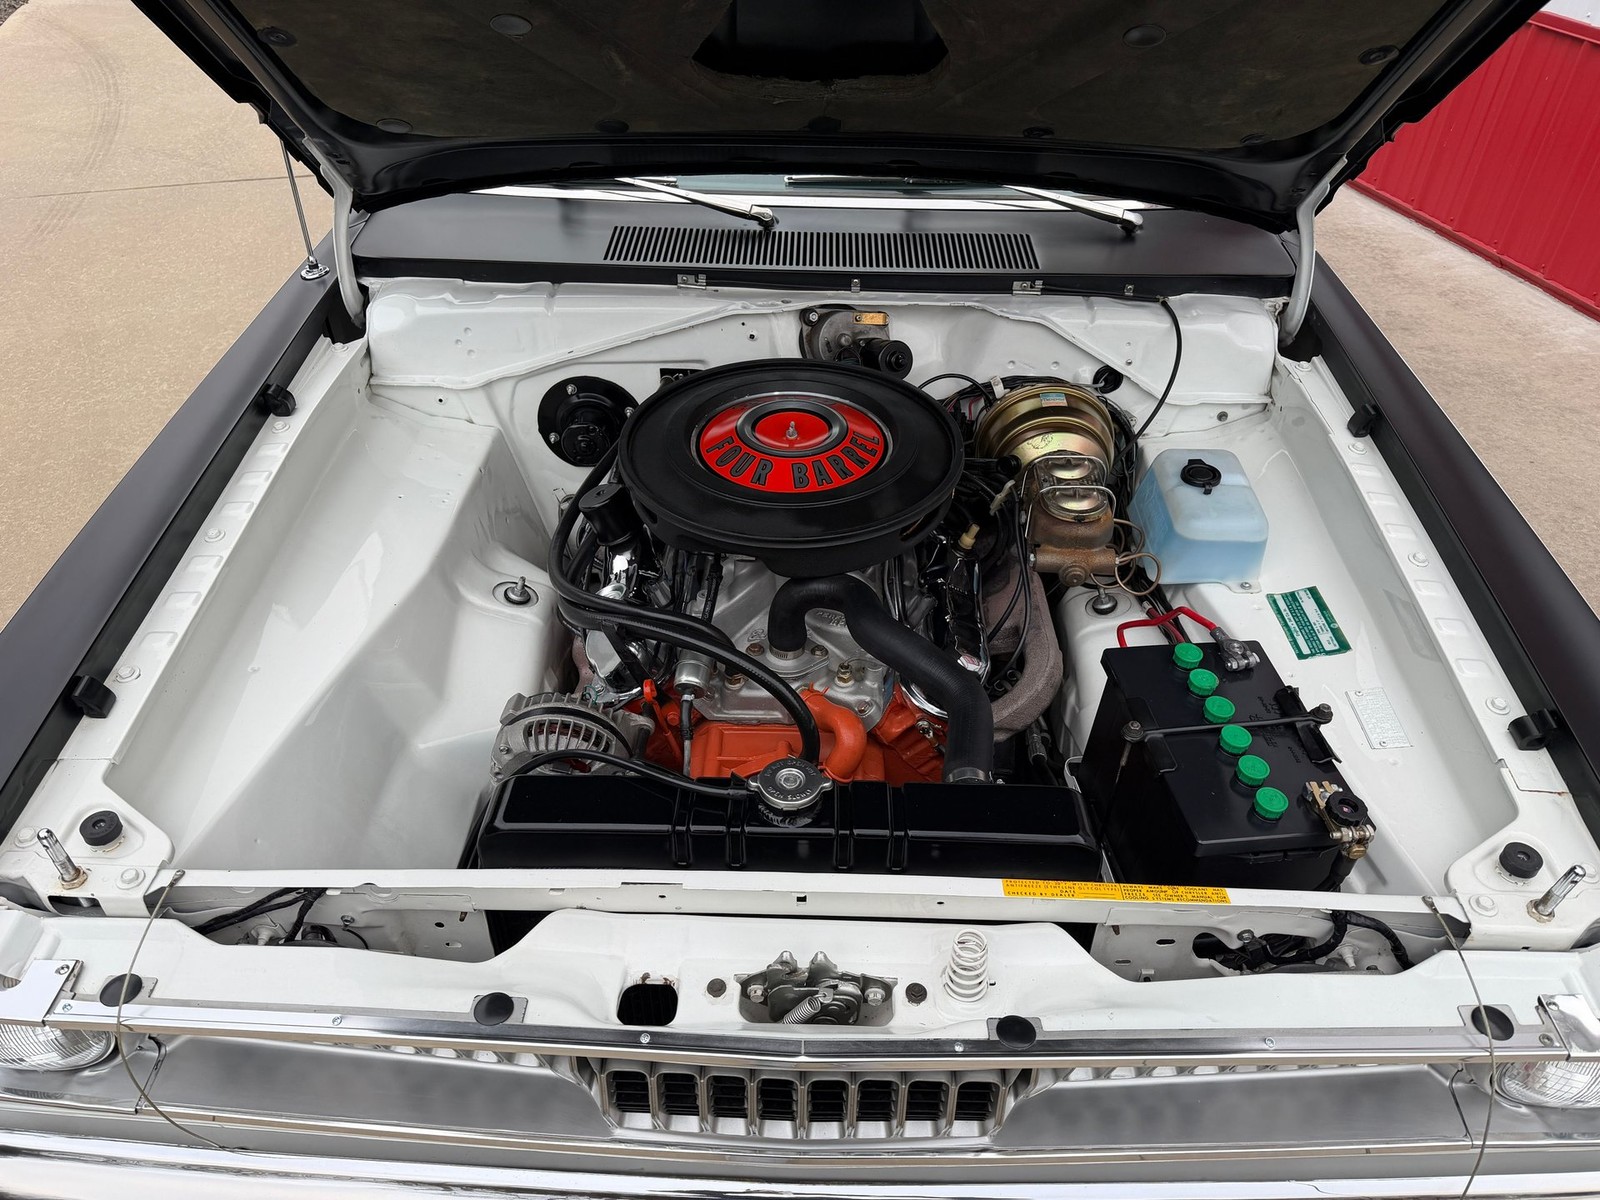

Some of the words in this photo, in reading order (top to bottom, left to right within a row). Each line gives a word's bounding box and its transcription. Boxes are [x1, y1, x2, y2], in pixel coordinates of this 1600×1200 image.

[706, 436, 774, 486] FOUR
[791, 431, 880, 490] BARREL
[767, 786, 785, 799] OPEN
